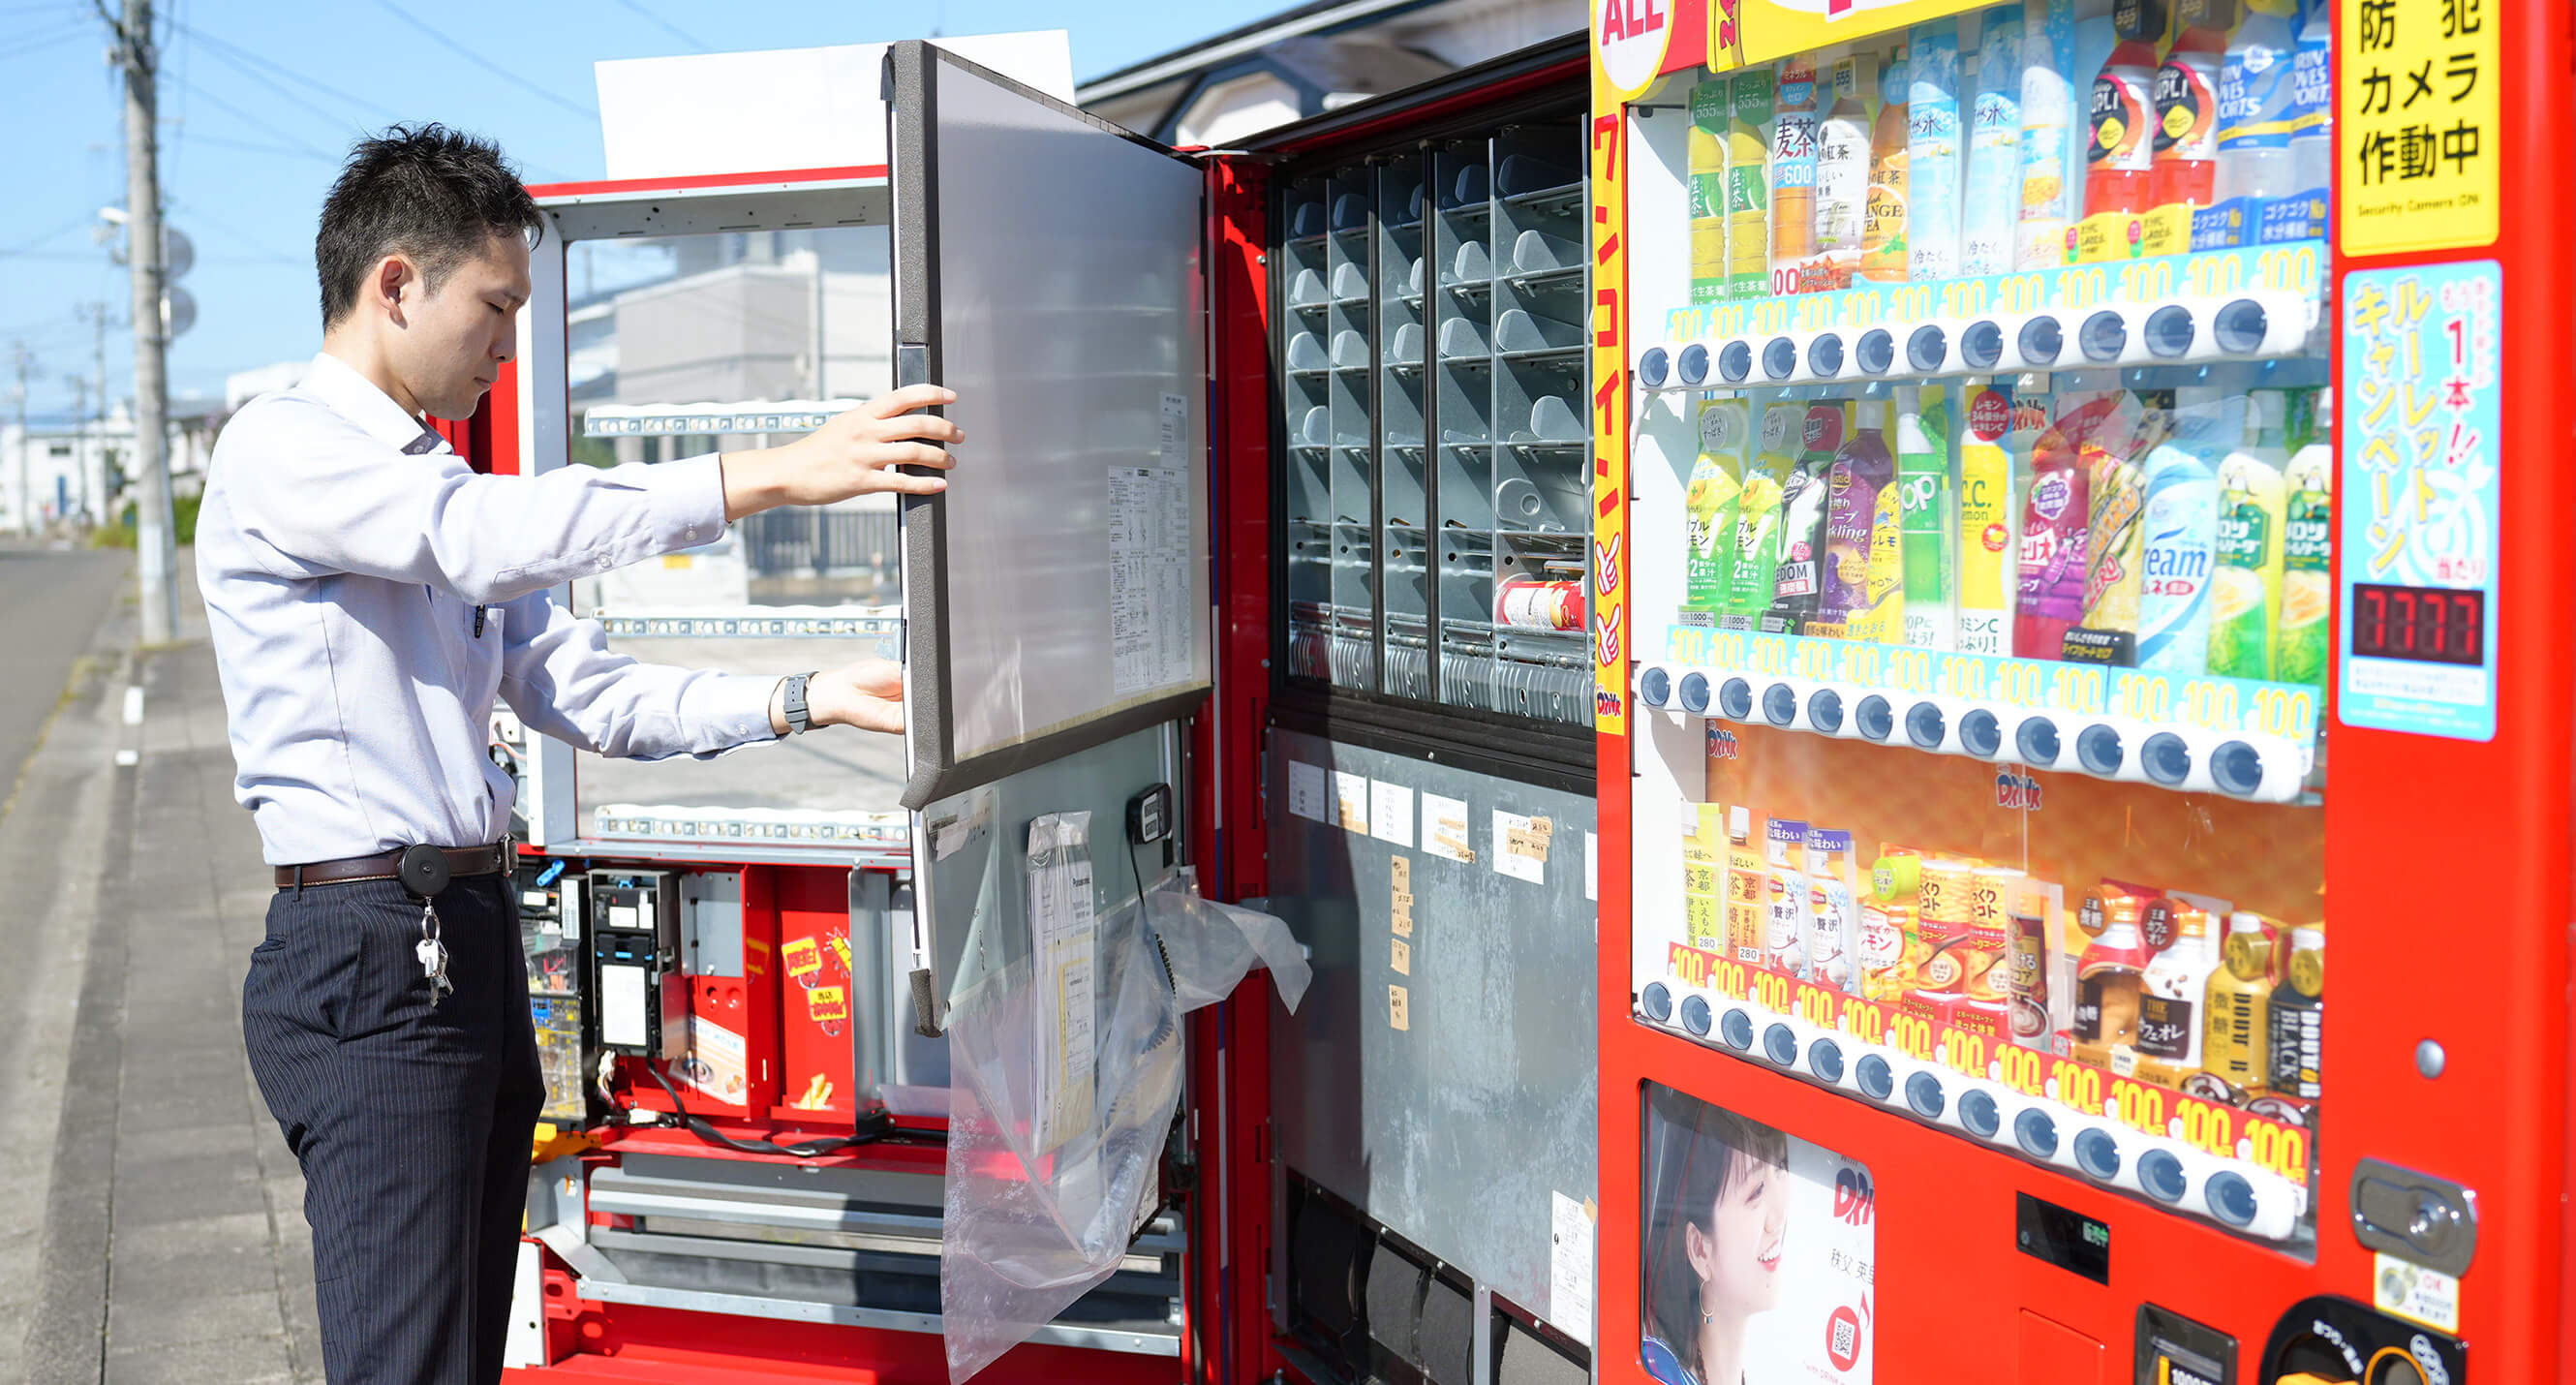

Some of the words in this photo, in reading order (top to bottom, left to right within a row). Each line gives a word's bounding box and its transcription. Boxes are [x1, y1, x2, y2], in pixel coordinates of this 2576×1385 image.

[2361, 0, 2481, 53] 防犯
[2361, 53, 2478, 114] カメラ
[1776, 116, 1817, 159] 麦茶
[1818, 144, 1849, 161] の紅茶
[2360, 119, 2479, 185] 作動中
[1732, 169, 1744, 209] 生茶
[1785, 165, 1812, 185] 600
[1869, 170, 1900, 186] の紅茶
[1865, 204, 1903, 218] ANGE
[2057, 267, 2105, 309] 100
[2120, 261, 2171, 303] 100
[2186, 254, 2241, 298] 100
[2256, 246, 2315, 294] 100
[1844, 291, 1881, 327] 100
[1892, 286, 1931, 323] 100
[1943, 280, 1985, 320] 100
[1998, 273, 2043, 315] 100
[1594, 113, 1619, 520] ワンコイン
[1671, 309, 1702, 343] 100
[1710, 305, 1743, 340] 100
[1753, 300, 1787, 336] 100
[1796, 295, 1832, 332] 100
[2394, 280, 2439, 522] ルーレット
[2354, 283, 2406, 570] キャンペーン
[1689, 559, 1699, 578] 2
[1733, 560, 1741, 579] 2
[2363, 589, 2477, 656] 7777
[1698, 869, 1711, 892] 京都
[1743, 877, 1757, 901] 京都
[1699, 938, 1716, 948] 280
[1739, 948, 1758, 960] 280
